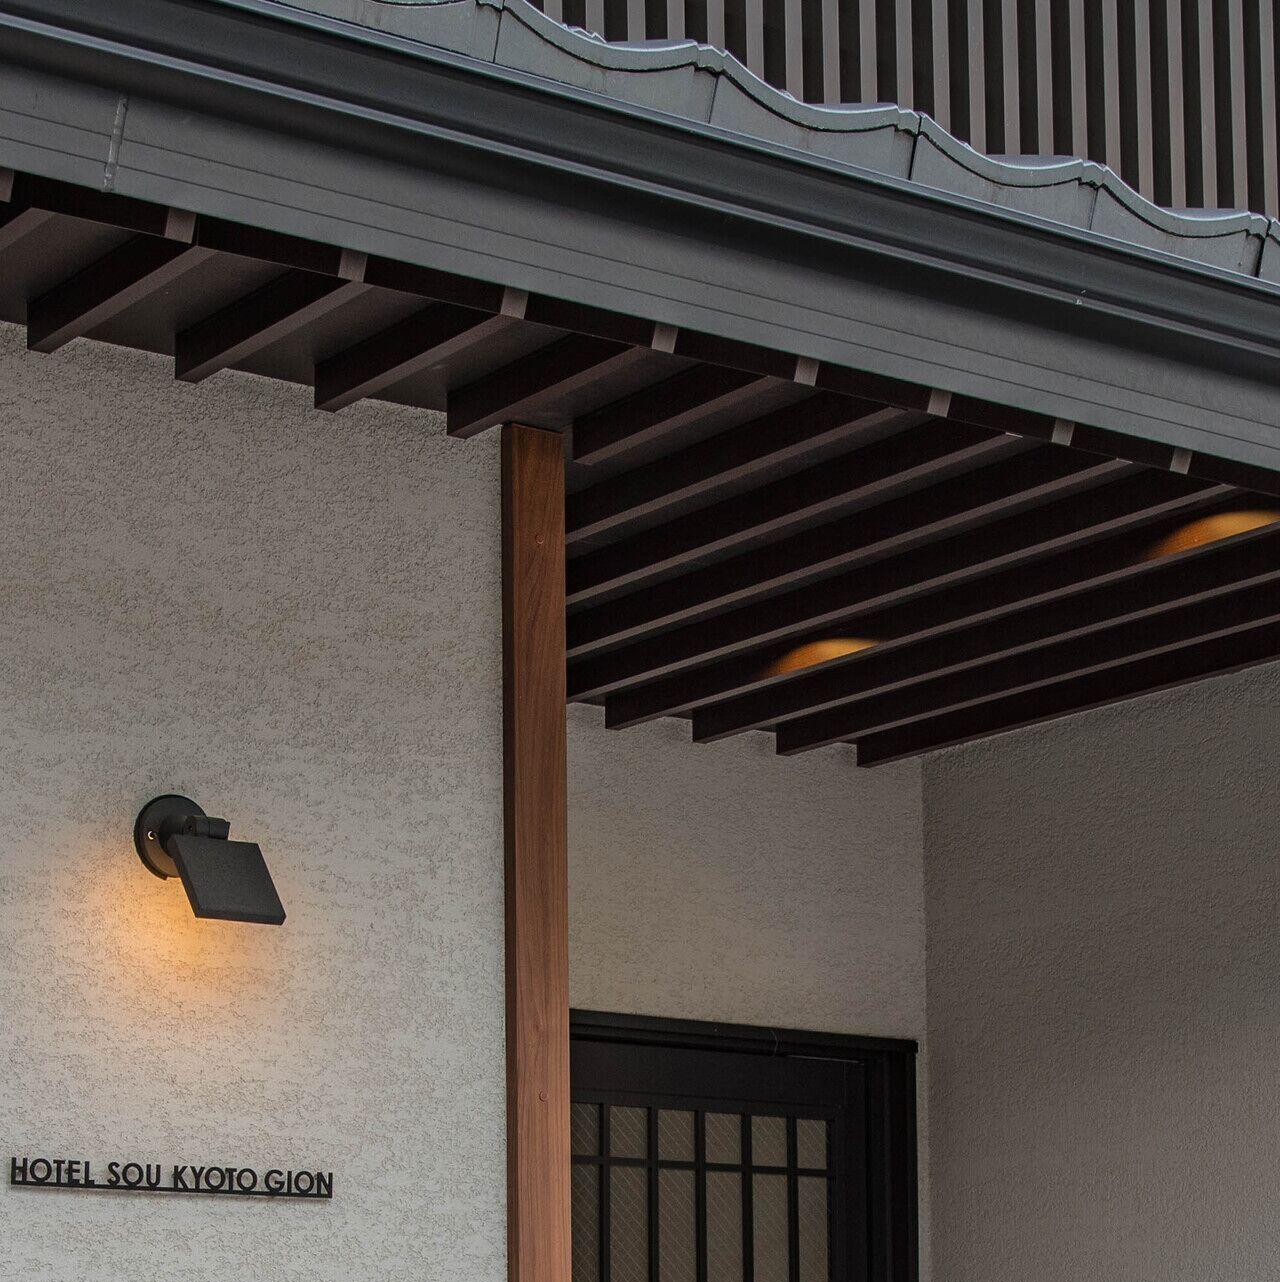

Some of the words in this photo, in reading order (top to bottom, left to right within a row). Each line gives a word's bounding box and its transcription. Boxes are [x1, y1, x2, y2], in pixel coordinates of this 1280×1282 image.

[10, 1157, 95, 1187] HOTEL
[106, 1161, 161, 1188] SOU
[173, 1165, 258, 1192] KYOTO
[264, 1169, 333, 1197] GION
